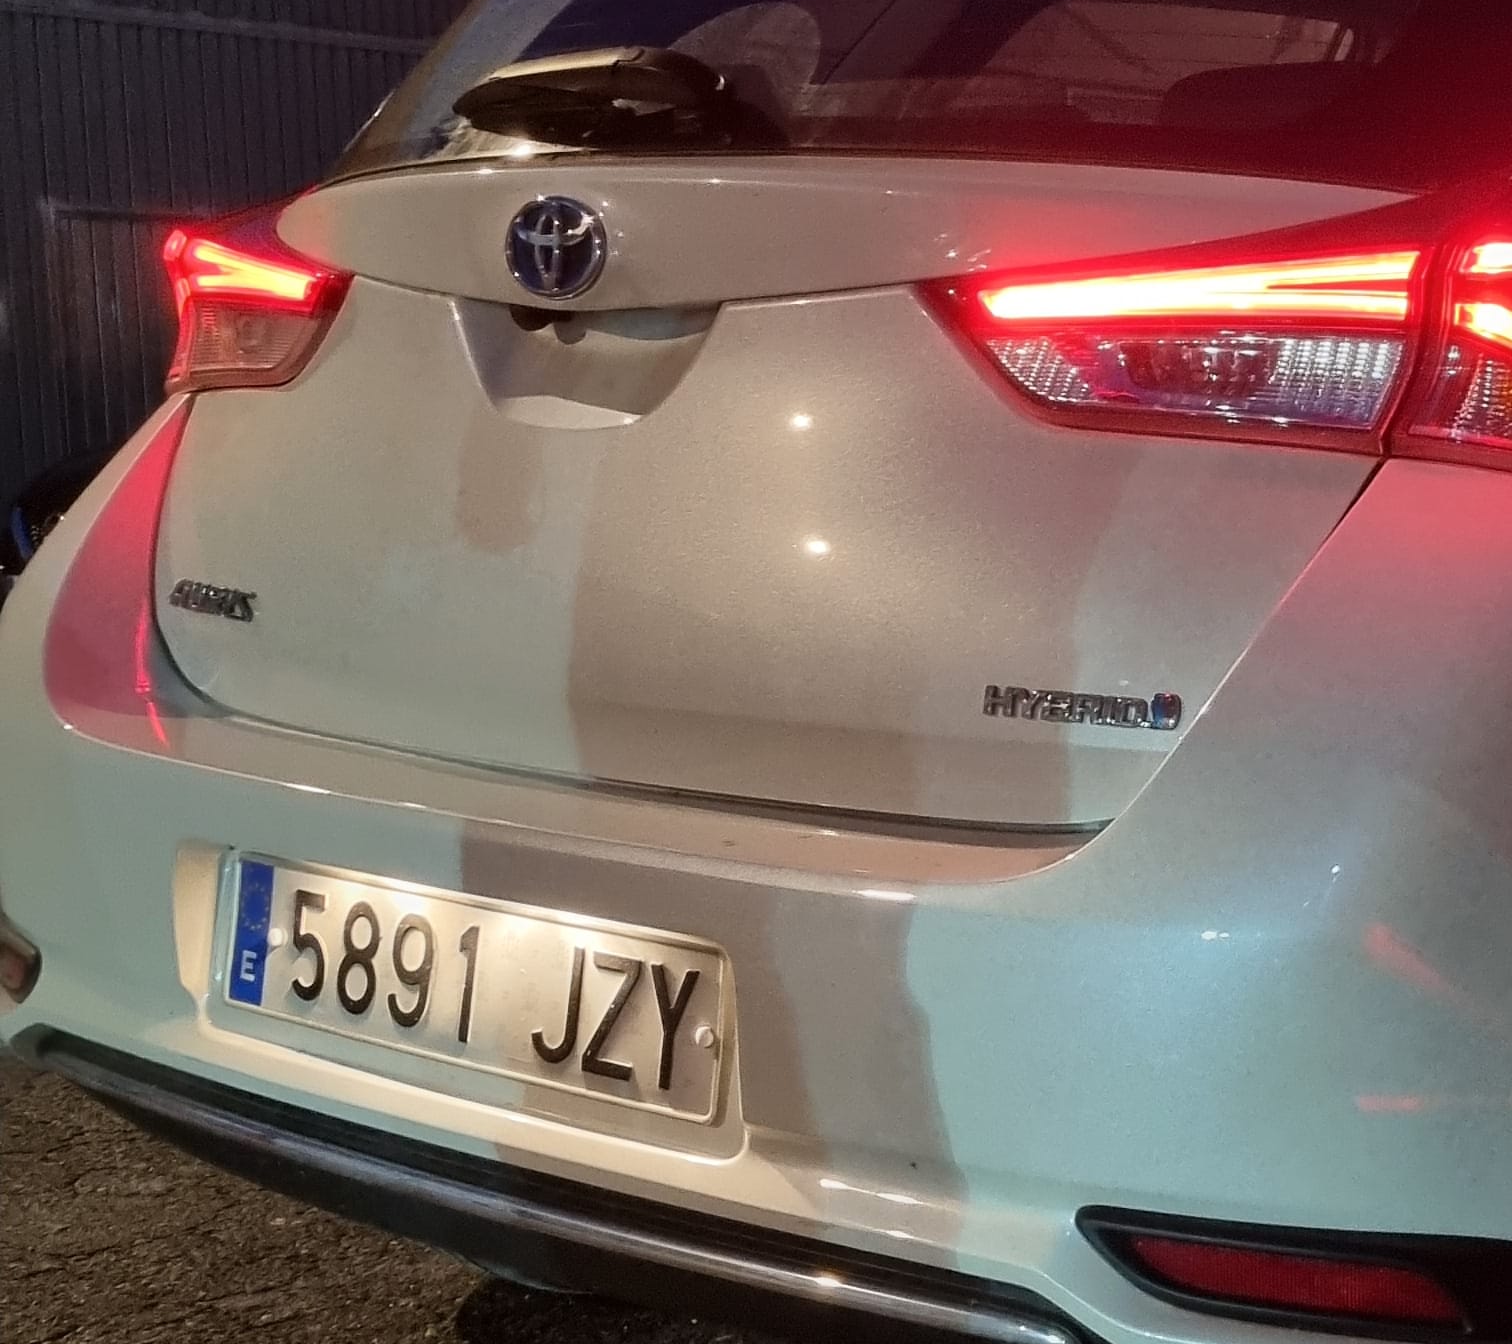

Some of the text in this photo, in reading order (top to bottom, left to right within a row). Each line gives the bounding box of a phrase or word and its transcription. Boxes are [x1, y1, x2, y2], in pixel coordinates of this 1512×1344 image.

[982, 685, 1150, 728] HYBRID
[240, 950, 256, 983] E
[291, 888, 701, 1091] 5891 JZY
